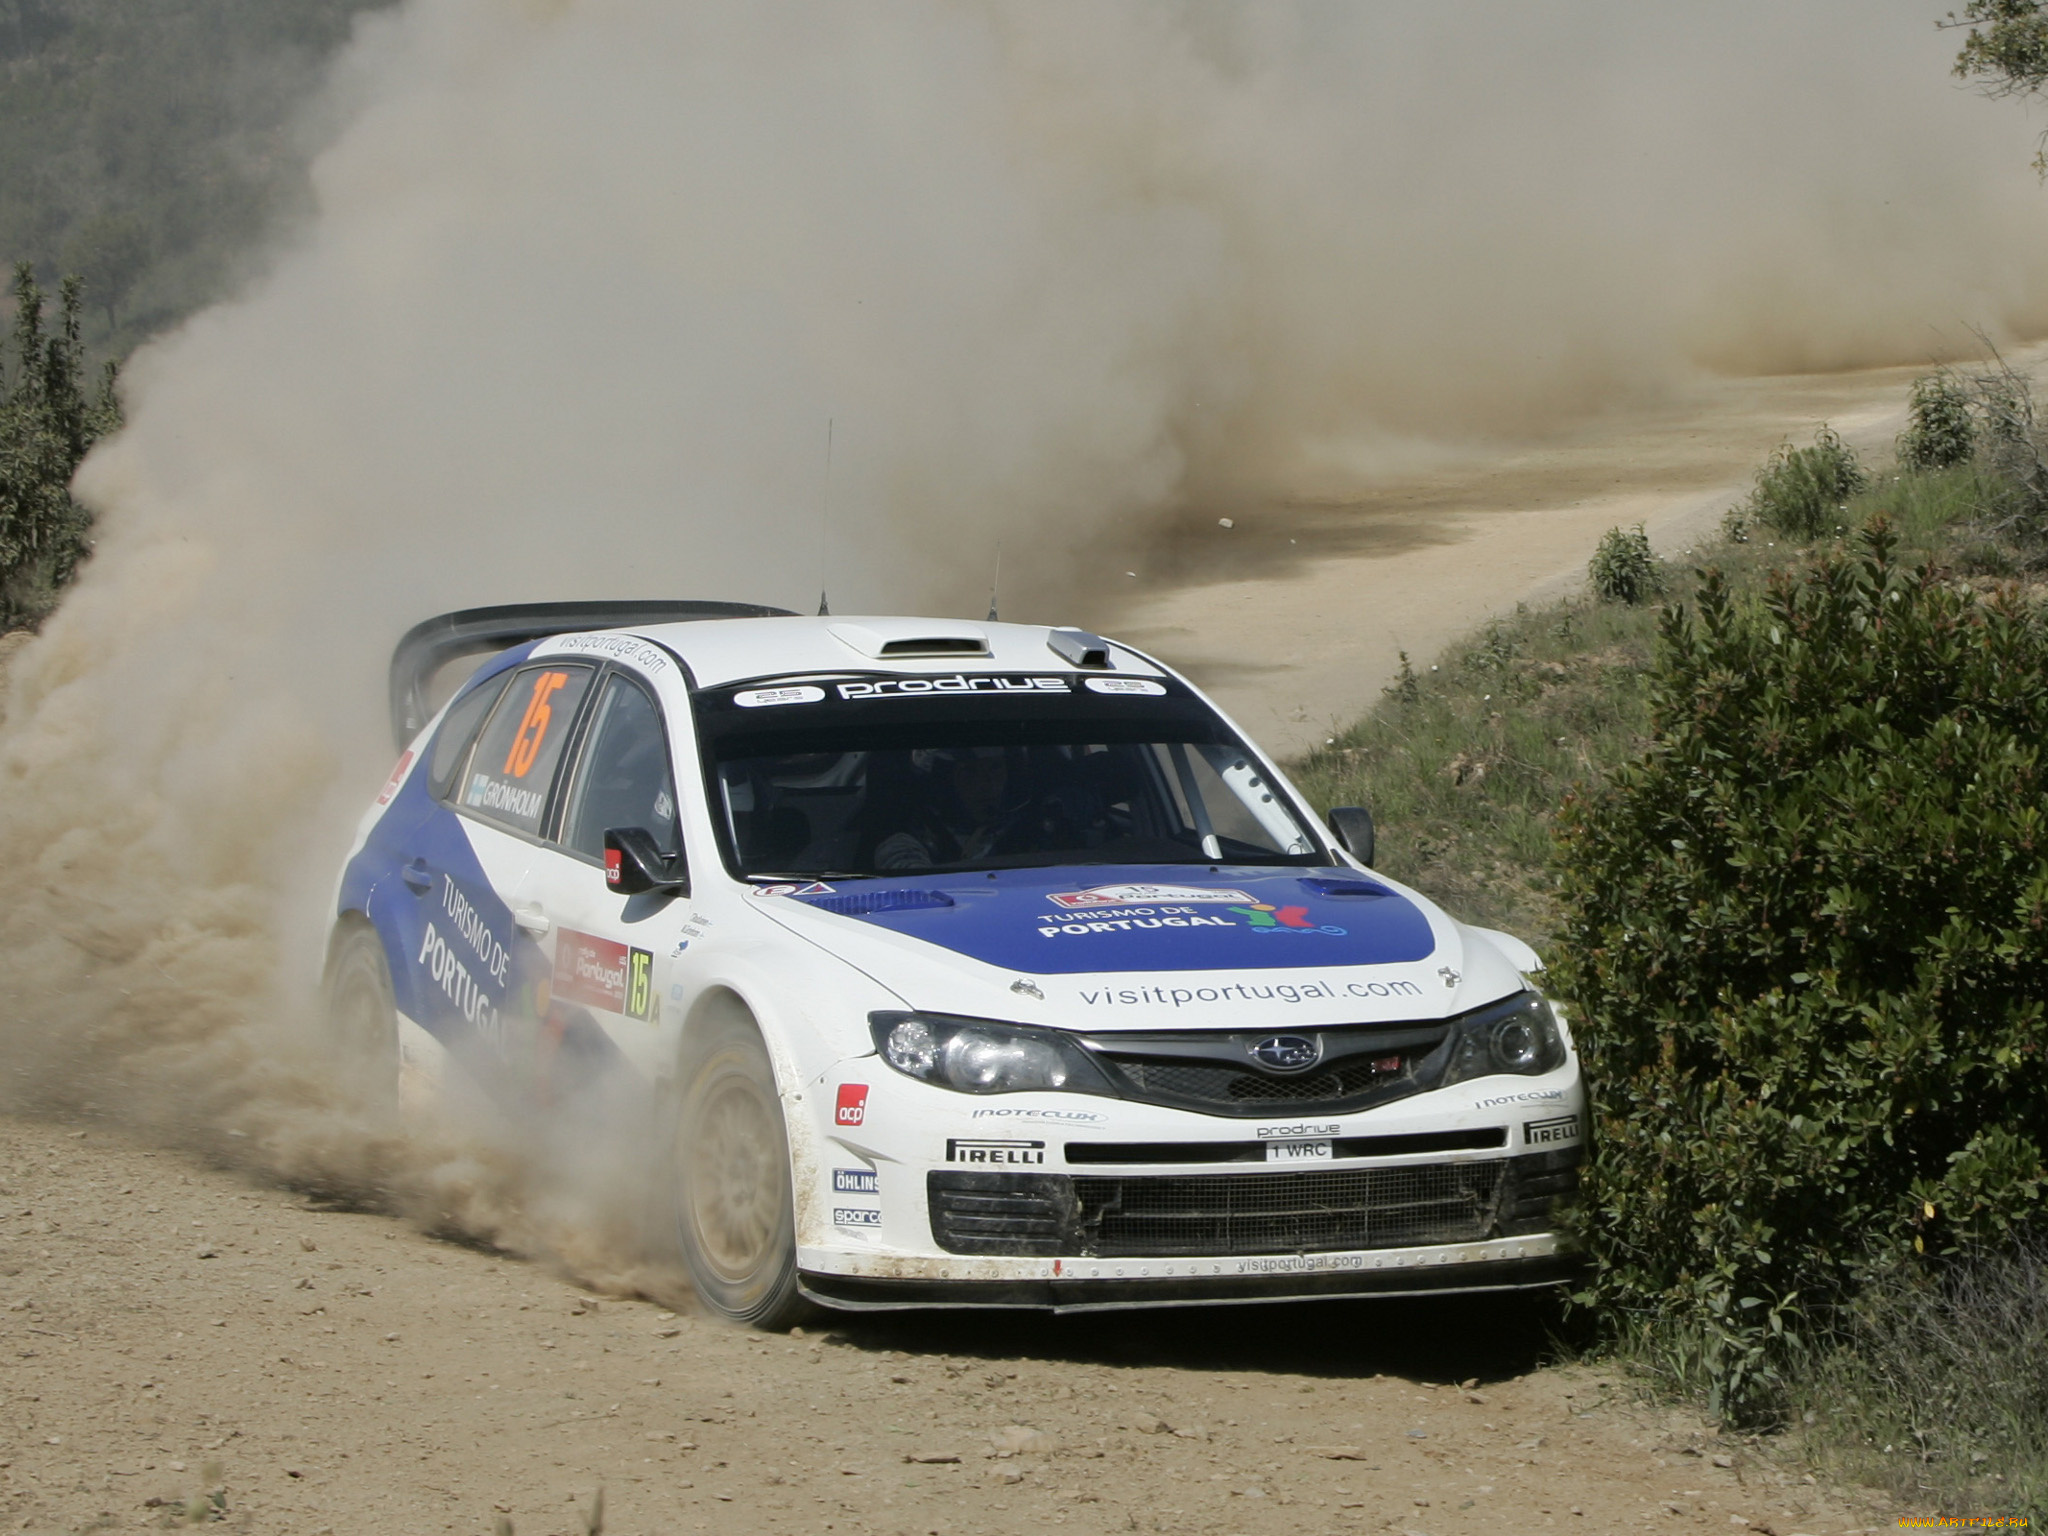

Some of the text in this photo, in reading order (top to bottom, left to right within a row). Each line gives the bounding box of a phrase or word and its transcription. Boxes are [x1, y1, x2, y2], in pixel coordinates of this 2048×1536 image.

[560, 636, 667, 674] visitportugal.com
[836, 675, 1071, 699] prodrive
[504, 671, 568, 777] 15
[483, 779, 542, 818] GRÖNHOLM
[1124, 885, 1159, 893] 15
[1037, 906, 1198, 924] TURISMO DE
[1037, 916, 1237, 938] PORTUGAL
[443, 873, 510, 987] TURISMO DE
[419, 922, 503, 1046] PORTUGA
[576, 956, 625, 990] Portugal
[631, 952, 650, 1015] 15
[1079, 978, 1424, 1008] visitportugal.com
[839, 1107, 863, 1123] acp
[1257, 1124, 1341, 1139] prodrive
[1522, 1114, 1579, 1145] PIRELLI
[946, 1138, 1046, 1164] PIRELLI
[1273, 1142, 1327, 1158] 1 WRC
[1238, 1255, 1363, 1273] visitportugal.com
